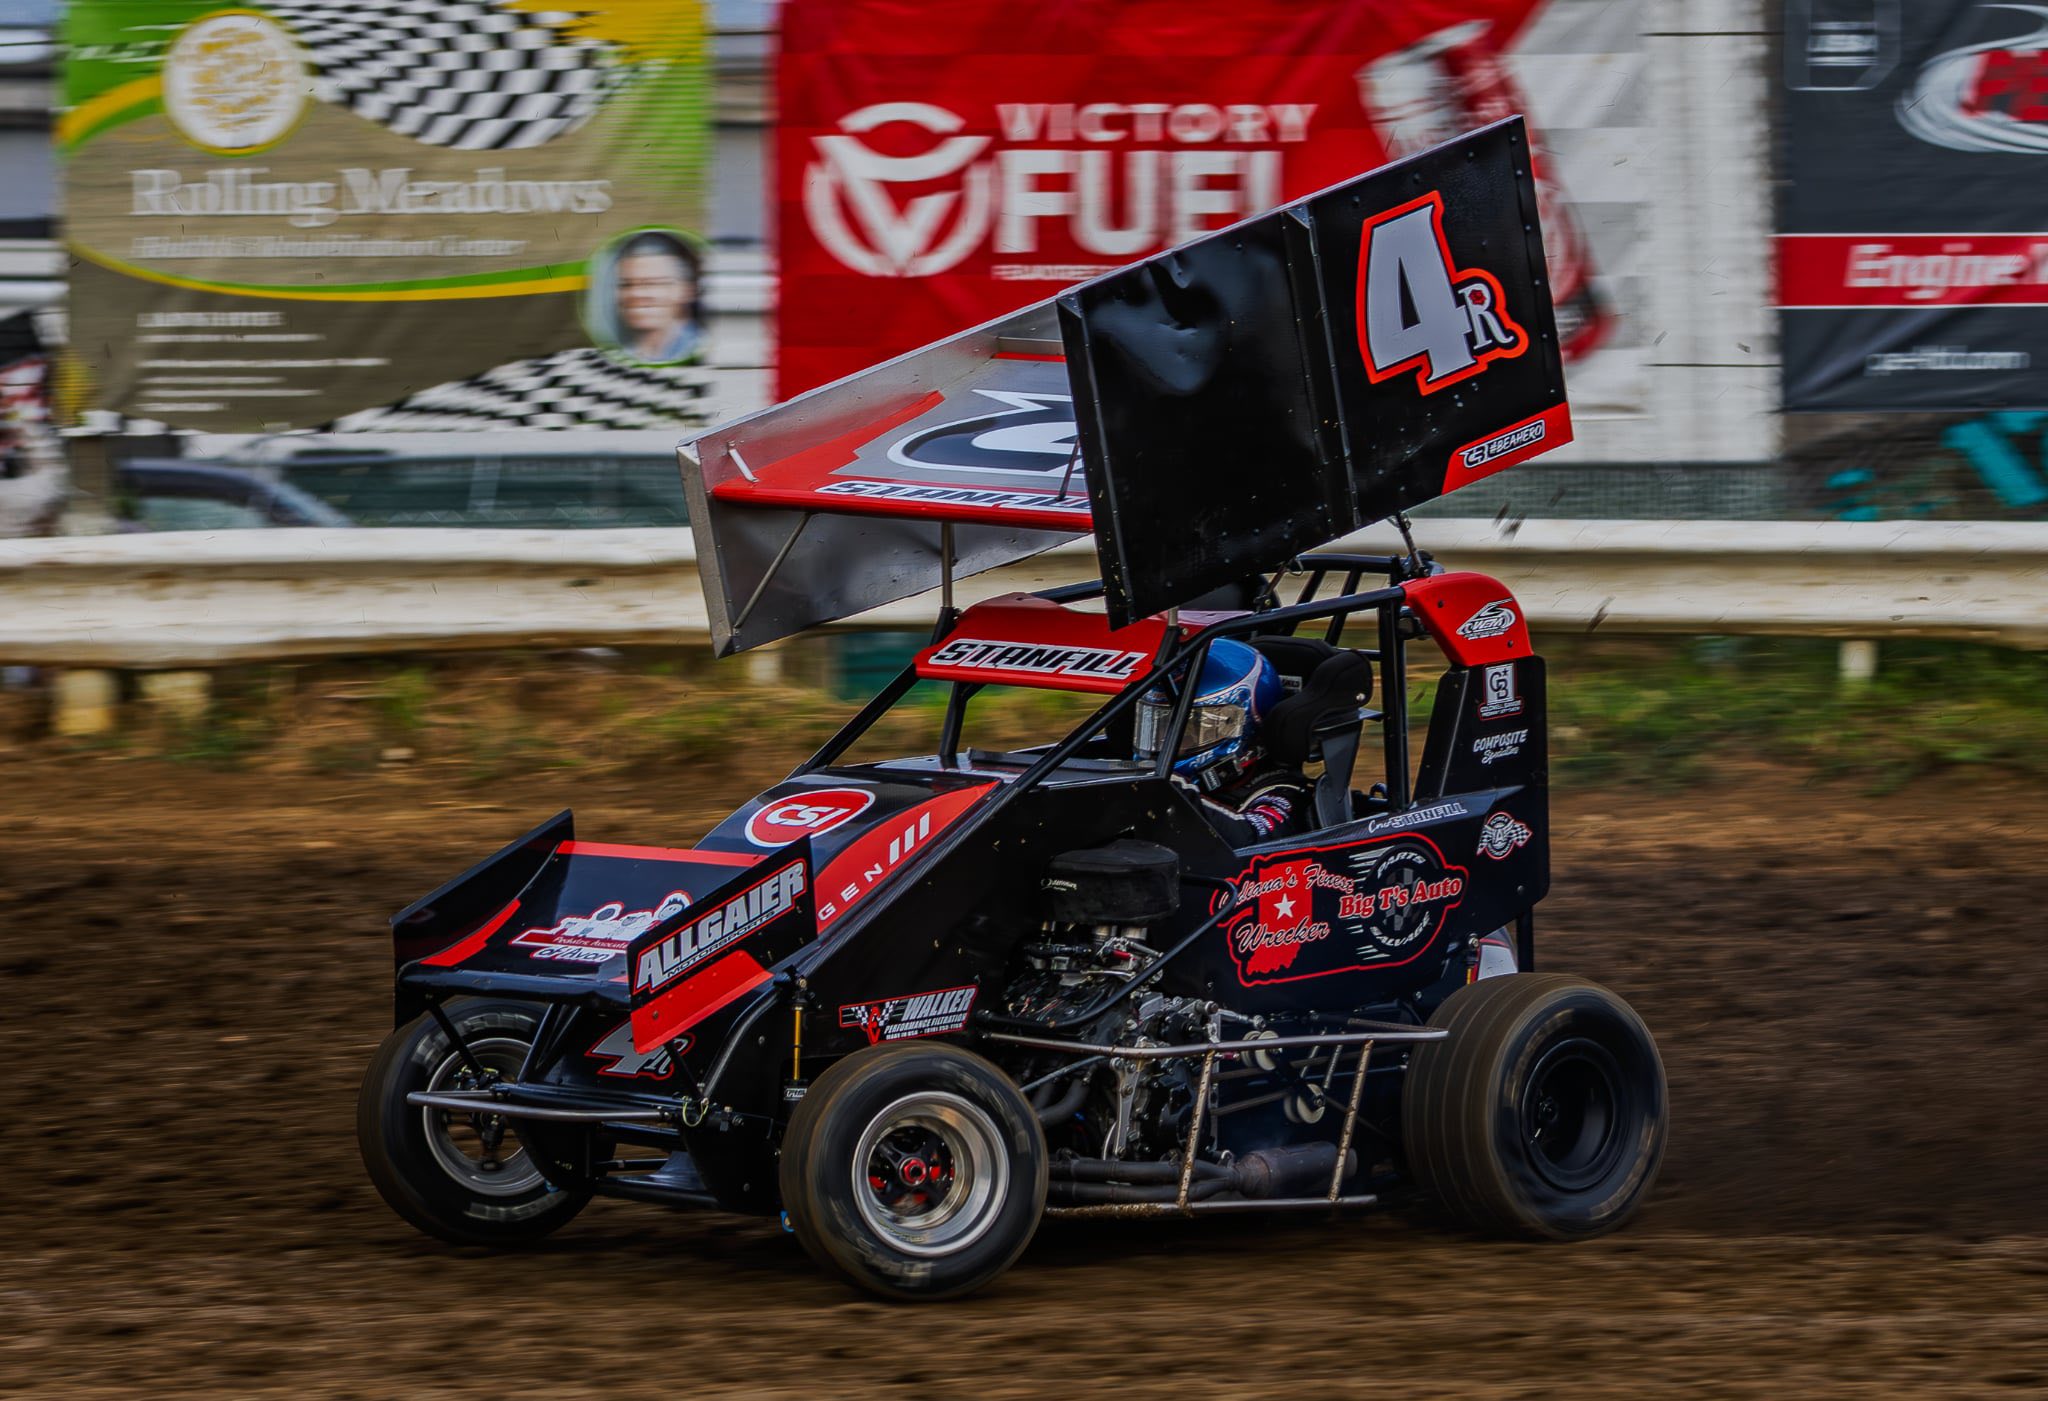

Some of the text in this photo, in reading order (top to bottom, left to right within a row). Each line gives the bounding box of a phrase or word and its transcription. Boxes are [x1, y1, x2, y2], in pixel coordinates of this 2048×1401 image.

[997, 103, 1319, 143] VICTORY
[130, 167, 613, 227] Rolling Meadows
[1843, 242, 2028, 299] Engine
[931, 639, 1144, 678] STANFILL
[1473, 729, 1528, 752] COMPOSITE
[1390, 802, 1468, 828] STANFILL
[1377, 851, 1426, 879] PARTS
[818, 862, 884, 922] GEN
[1338, 876, 1463, 919] Big T's Auto
[636, 862, 805, 990] ALLGAIER
[1235, 915, 1331, 954] Wrecker
[1369, 911, 1432, 948] SALVAGE
[901, 987, 977, 1022] WALKER
[884, 1018, 931, 1035] PERFORMANCE
